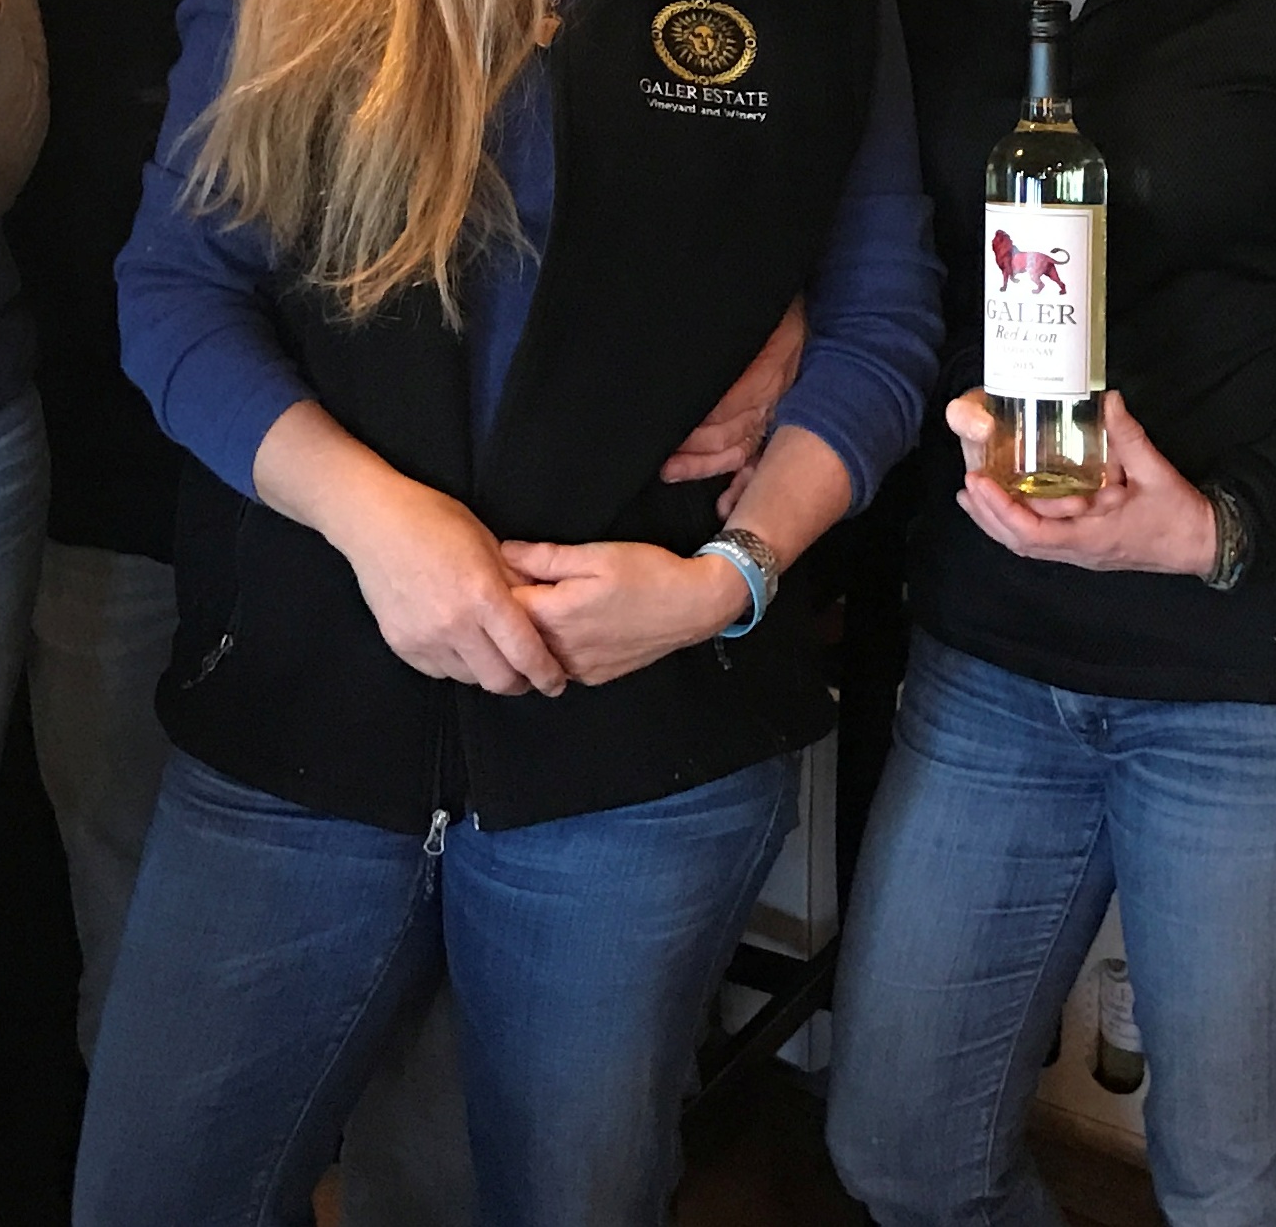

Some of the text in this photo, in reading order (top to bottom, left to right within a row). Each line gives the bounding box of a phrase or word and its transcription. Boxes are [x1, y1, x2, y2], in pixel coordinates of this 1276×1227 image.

[639, 77, 769, 107] GALER ESTATE
[647, 97, 767, 122] Vineyard and Winery
[986, 298, 1078, 325] GALER
[996, 324, 1020, 340] Red
